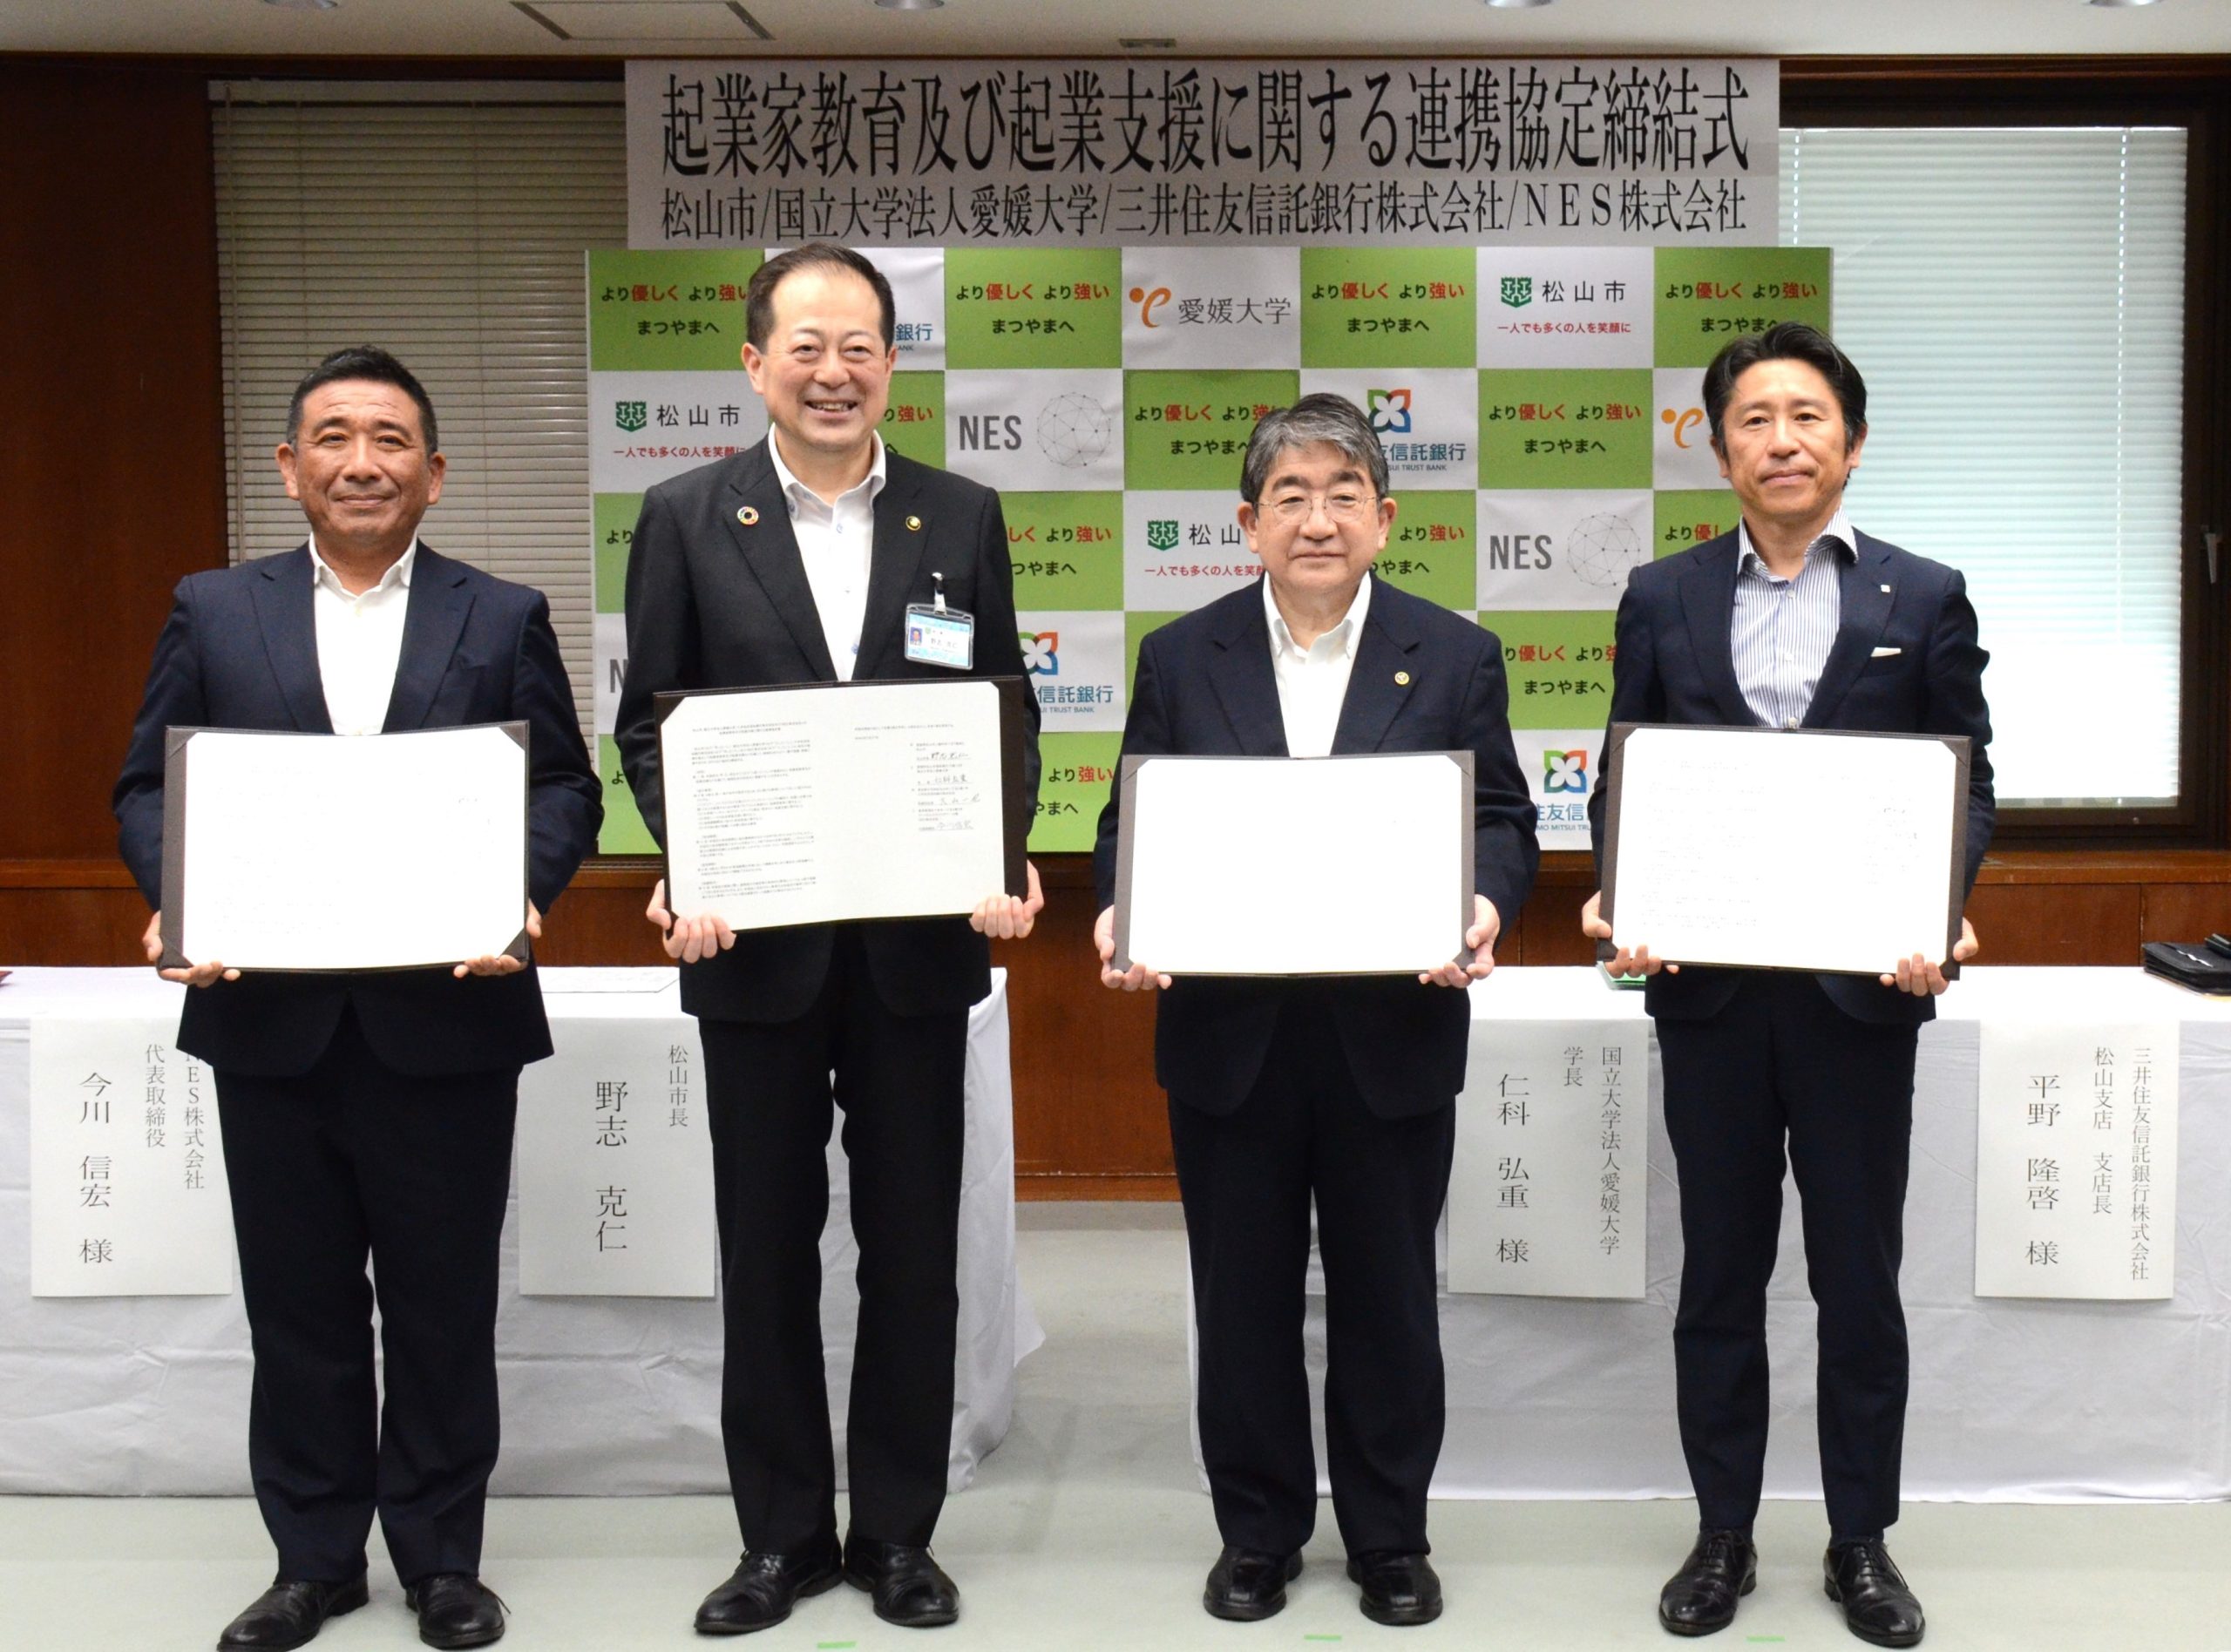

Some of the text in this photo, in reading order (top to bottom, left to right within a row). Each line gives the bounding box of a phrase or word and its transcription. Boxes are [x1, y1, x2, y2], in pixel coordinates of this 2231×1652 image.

[661, 66, 1749, 177] 起業家教育及び起業支援に関する連携協定締結式
[601, 285, 678, 301] より優しく
[956, 283, 1109, 301] より優しく より強い
[1311, 282, 1464, 300] より優しく より強い
[1542, 280, 1626, 303] 松山市
[1665, 282, 1817, 299] より優しく より強い
[1178, 297, 1292, 325] 愛媛大学
[637, 320, 720, 335] まつやまへ
[896, 323, 933, 342] 銀行
[992, 319, 1075, 335] まつやまへ
[1347, 317, 1430, 334] まつやまへ
[1498, 322, 1631, 334] 一人でも多くの人を笑顔に
[656, 404, 741, 427] 松山市
[1135, 404, 1271, 422] より優しく より強
[1488, 403, 1642, 421] より優しく より強い
[959, 415, 1022, 451] NES
[1524, 438, 1606, 454] まつやまへ
[1046, 525, 1112, 543] より強い
[1189, 524, 1241, 545] 松山
[1399, 525, 1465, 541] より強い
[1489, 534, 1552, 570] NES
[1012, 561, 1077, 577] つやまへ
[1505, 645, 1565, 661] り優しく
[1037, 685, 1114, 704] 信託銀行
[1524, 680, 1606, 695] まつやまへ
[1563, 1046, 1583, 1087] 学長
[668, 1045, 688, 1127] 松山市長
[146, 1044, 166, 1148] 代表取締役
[2092, 1046, 2115, 1215] 松山支店 支店長
[1600, 1046, 1622, 1256] 国立大学法人愛媛大学
[79, 1072, 113, 1264] 今川 信宏 様
[595, 1081, 628, 1252] 野志 克仁
[1495, 1073, 1530, 1263] 仁科 弘重 様
[2024, 1074, 2061, 1266] 平野 隆啓 様
[2131, 1047, 2152, 1281] 三井住友信託銀行株式会社
